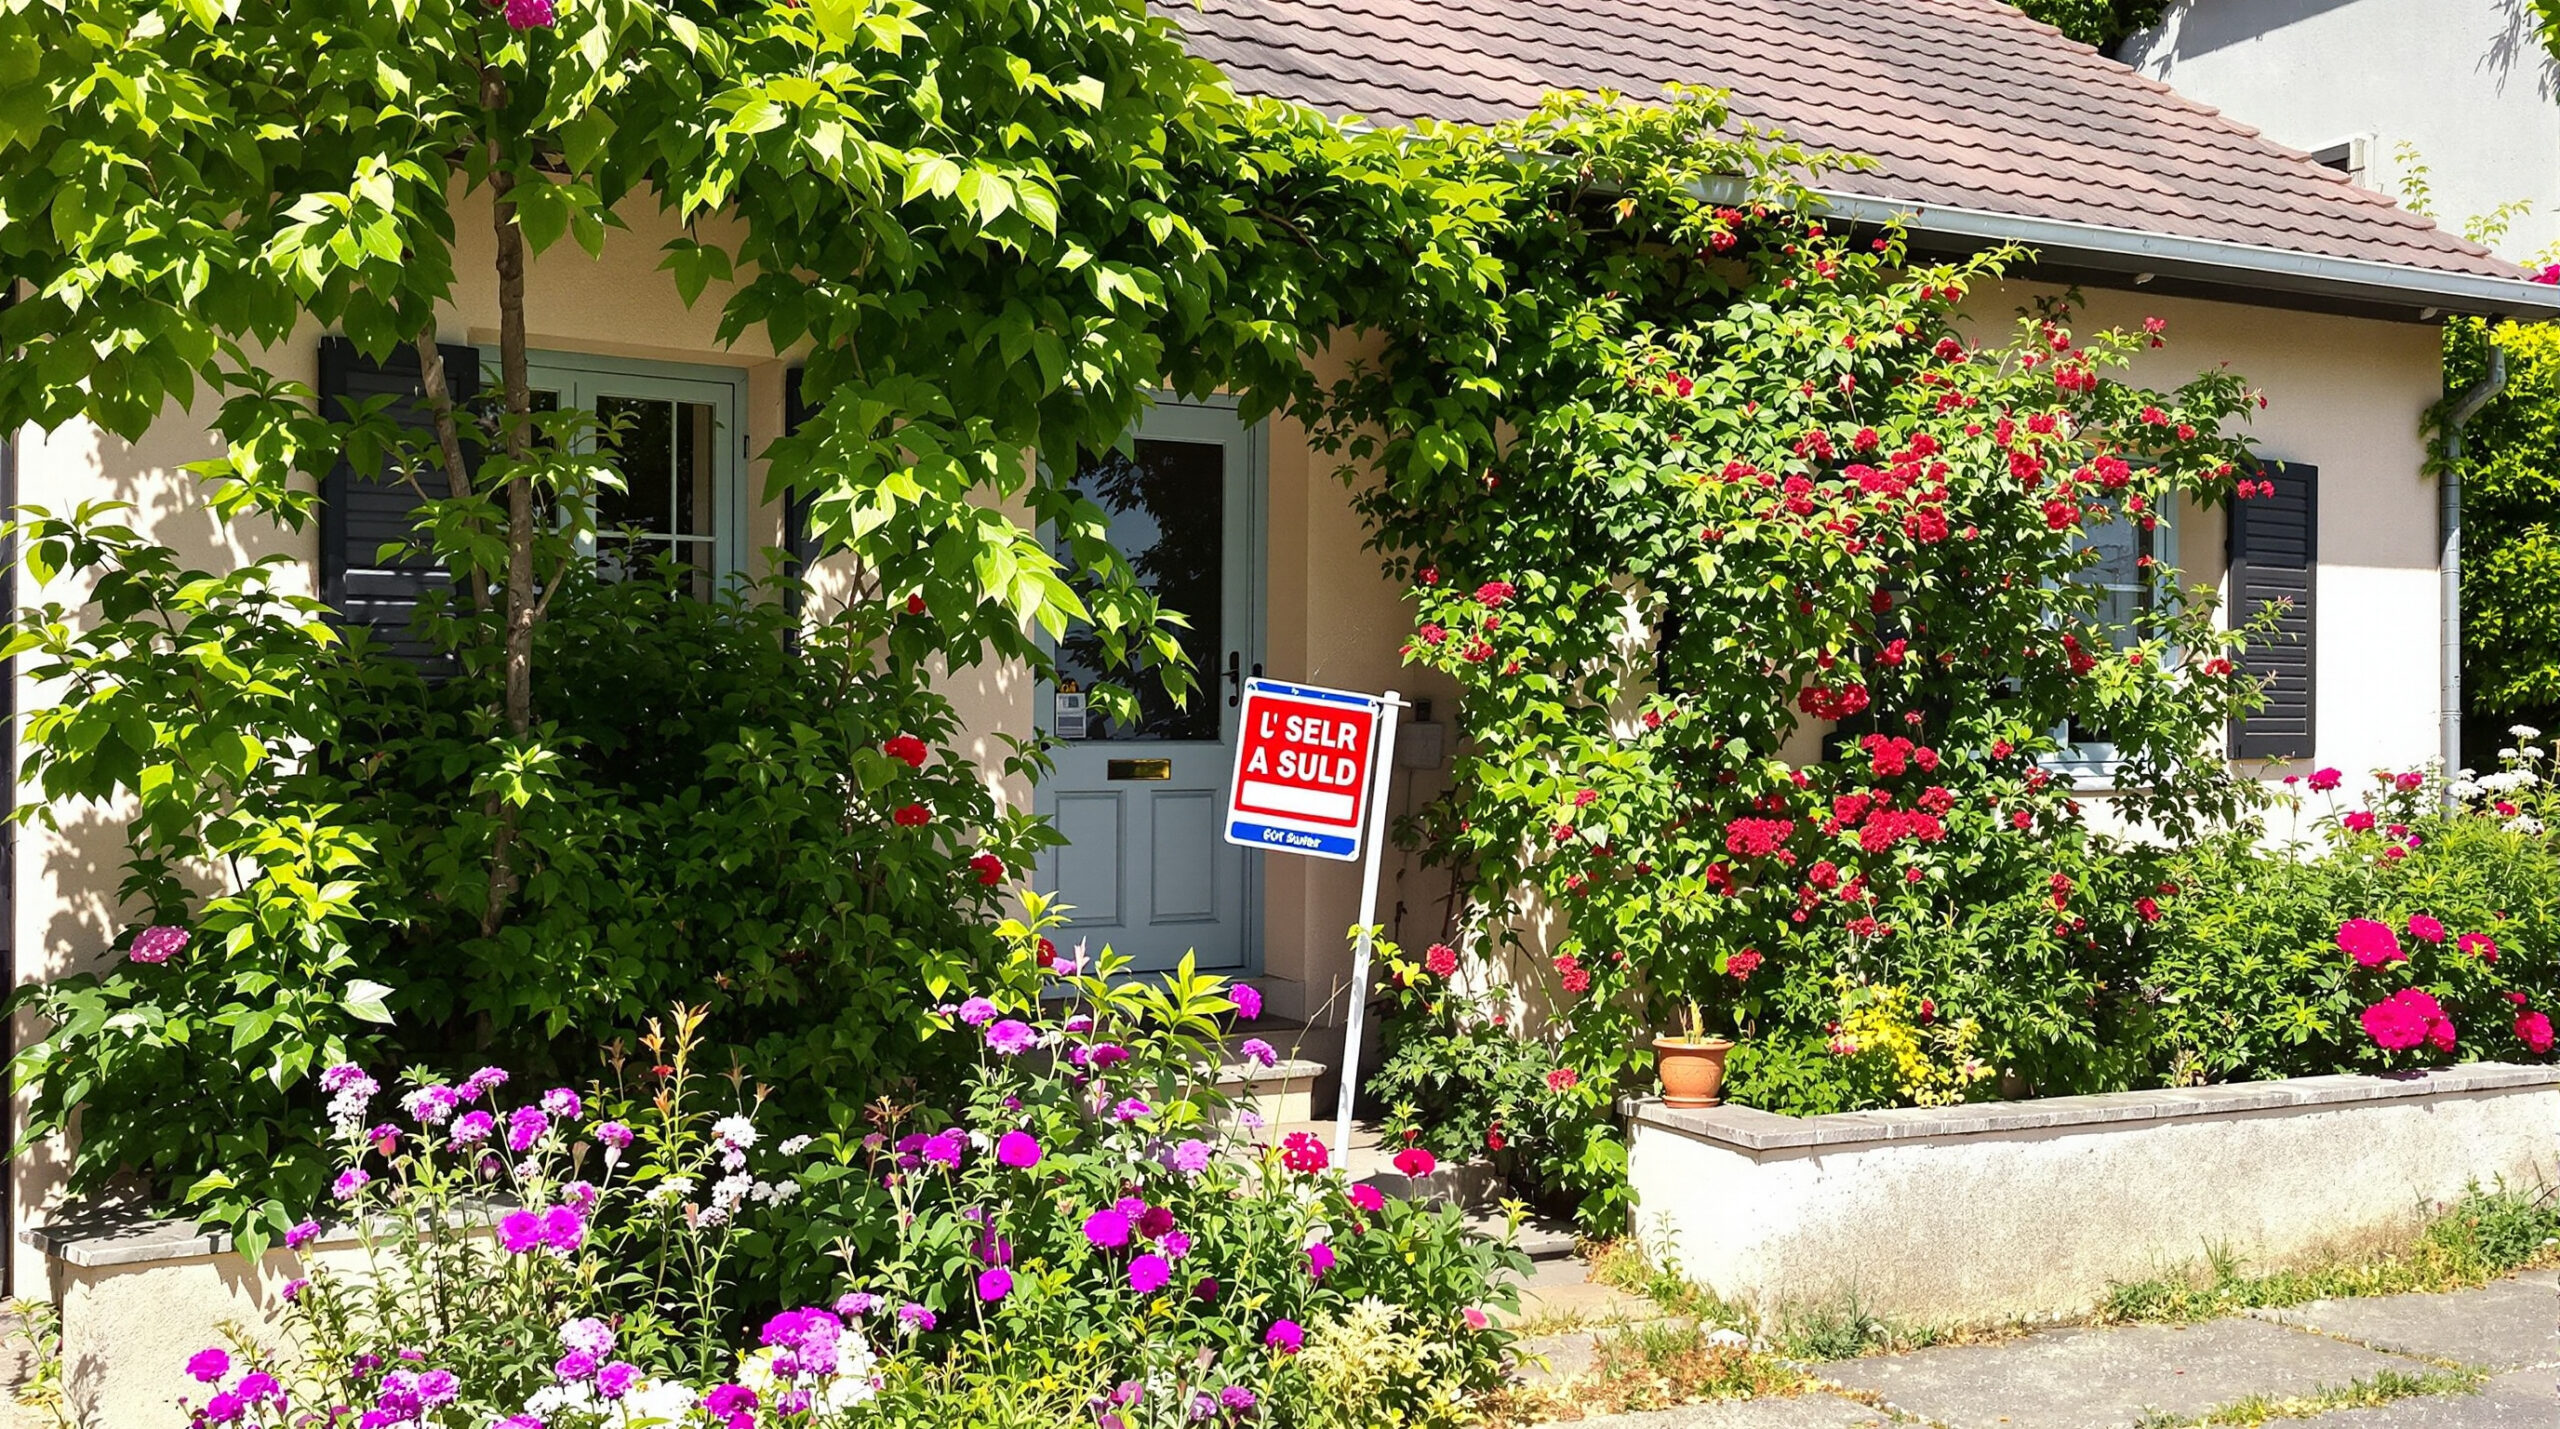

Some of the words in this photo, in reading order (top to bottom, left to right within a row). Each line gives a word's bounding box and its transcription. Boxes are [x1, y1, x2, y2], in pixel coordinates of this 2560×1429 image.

[1285, 715, 1358, 752] SELR
[1247, 746, 1269, 775] A
[1277, 750, 1356, 786] SULD
